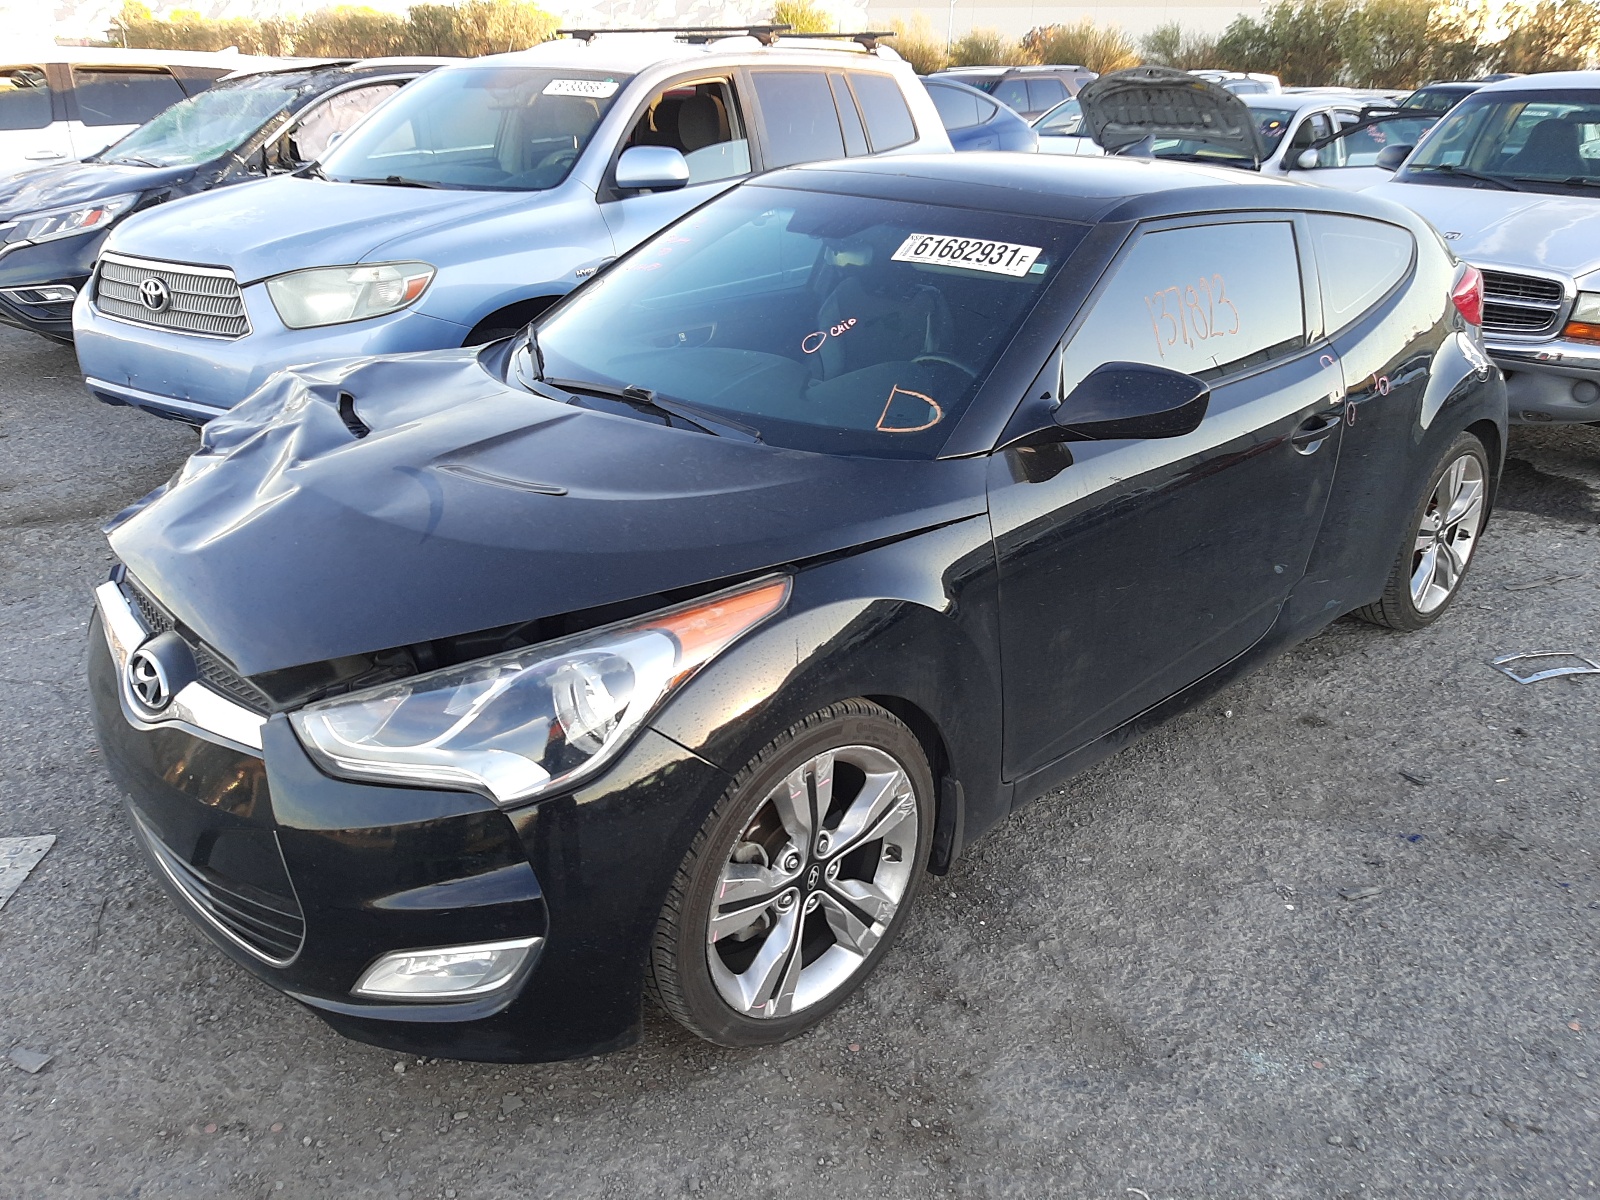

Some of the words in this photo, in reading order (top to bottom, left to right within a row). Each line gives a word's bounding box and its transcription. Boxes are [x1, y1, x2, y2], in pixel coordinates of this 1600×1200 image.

[913, 236, 1021, 266] 61682931
[1016, 255, 1029, 266] F
[1144, 273, 1240, 361] 137,823
[875, 384, 942, 433] D
